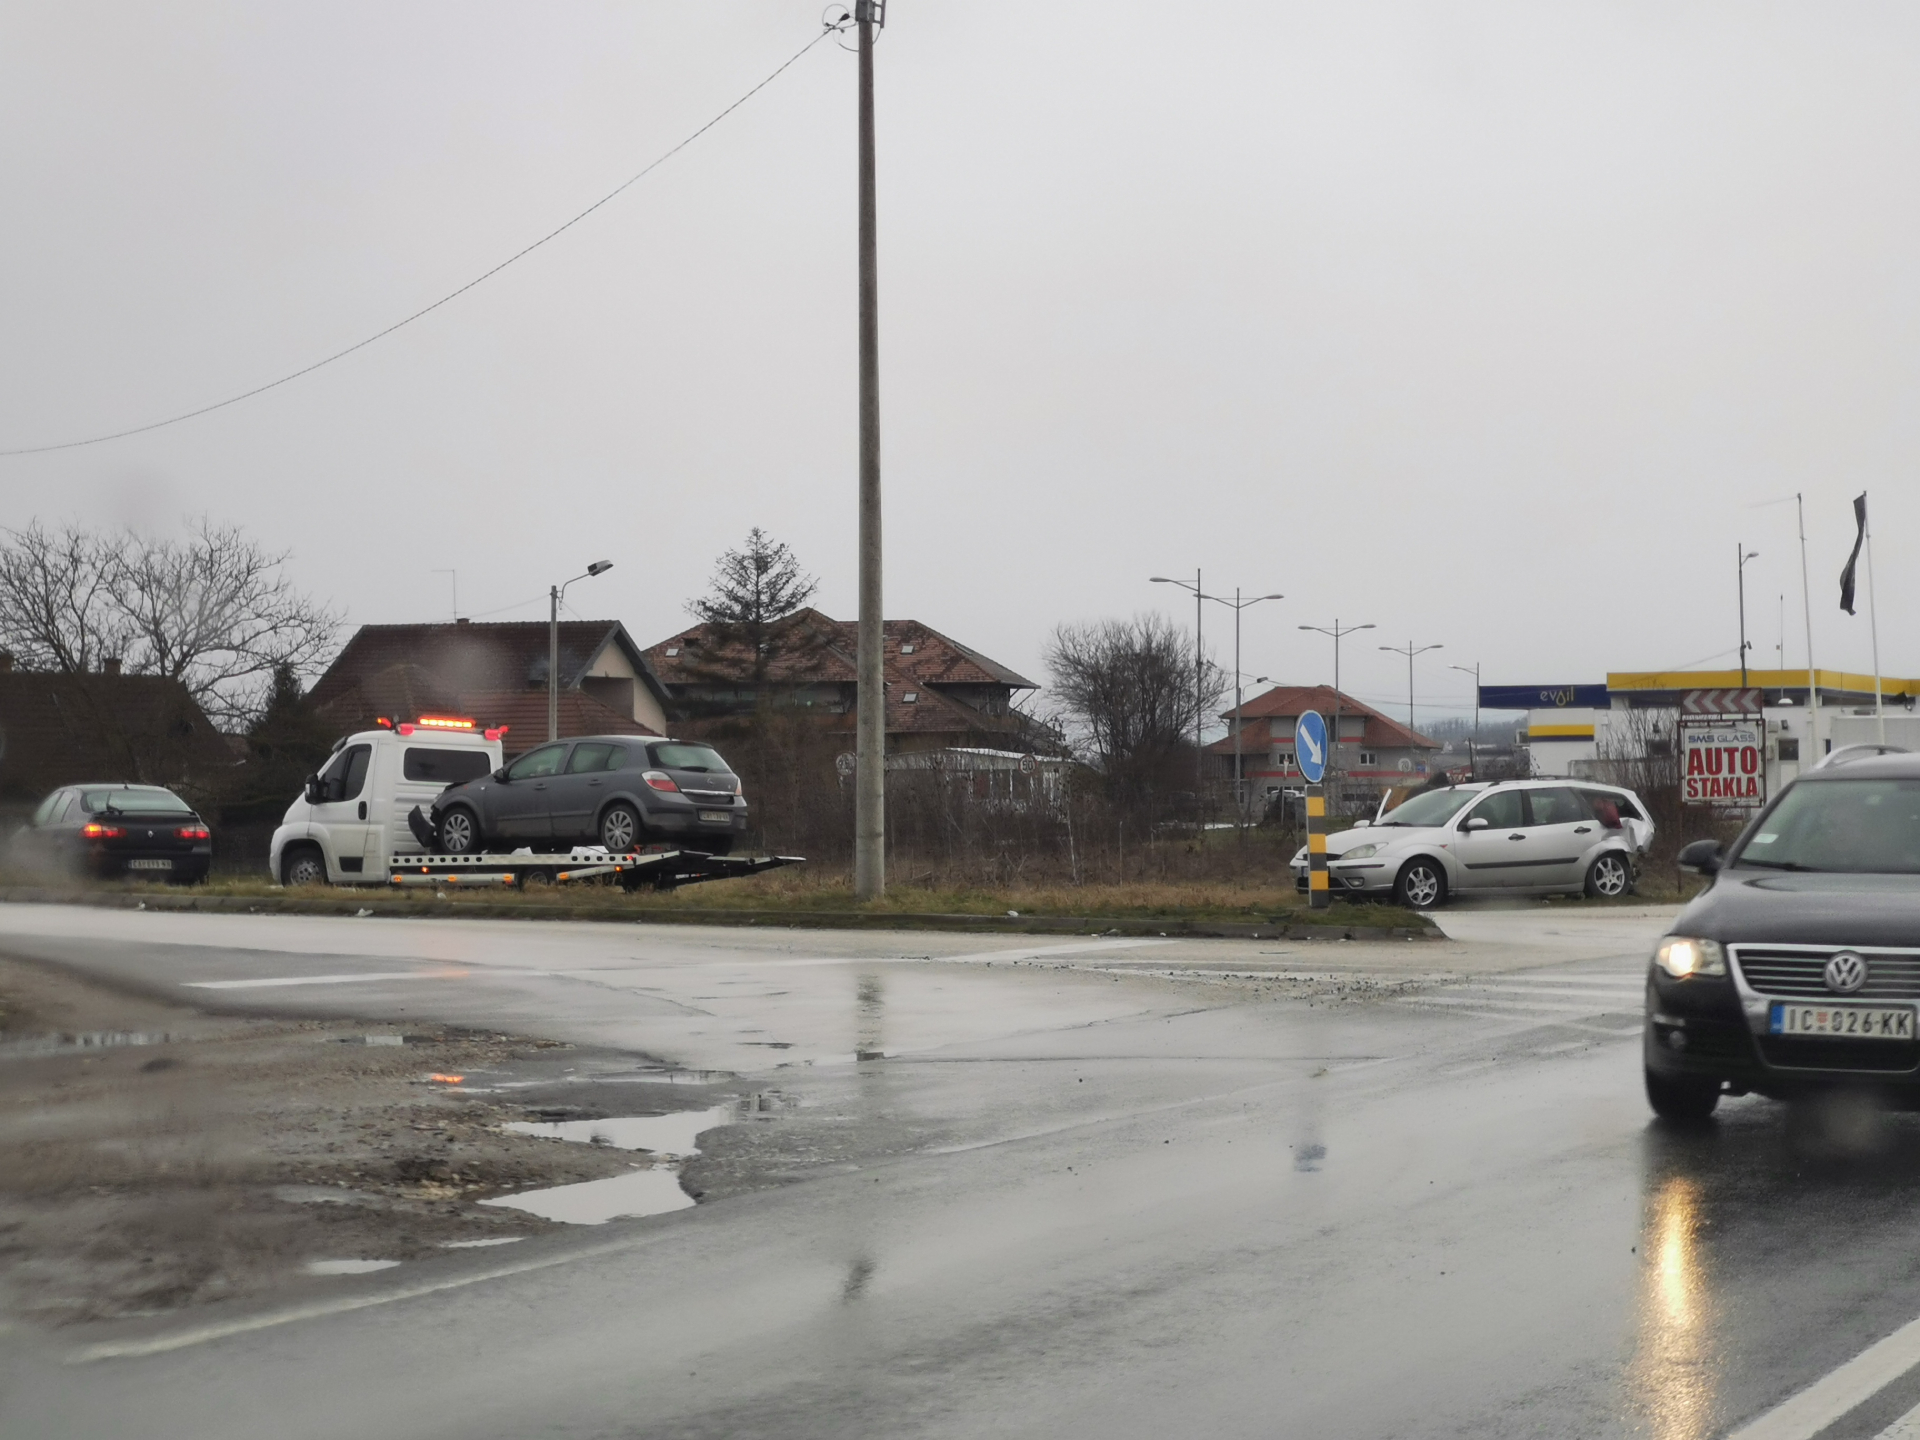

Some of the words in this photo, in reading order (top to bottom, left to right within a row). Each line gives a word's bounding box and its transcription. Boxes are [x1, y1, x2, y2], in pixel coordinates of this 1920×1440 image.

[1688, 735, 1715, 743] SMS
[1717, 734, 1756, 743] GLASS
[1687, 746, 1758, 776] AUTO
[1687, 777, 1758, 798] STAKLA
[1789, 1008, 1813, 1031] IC
